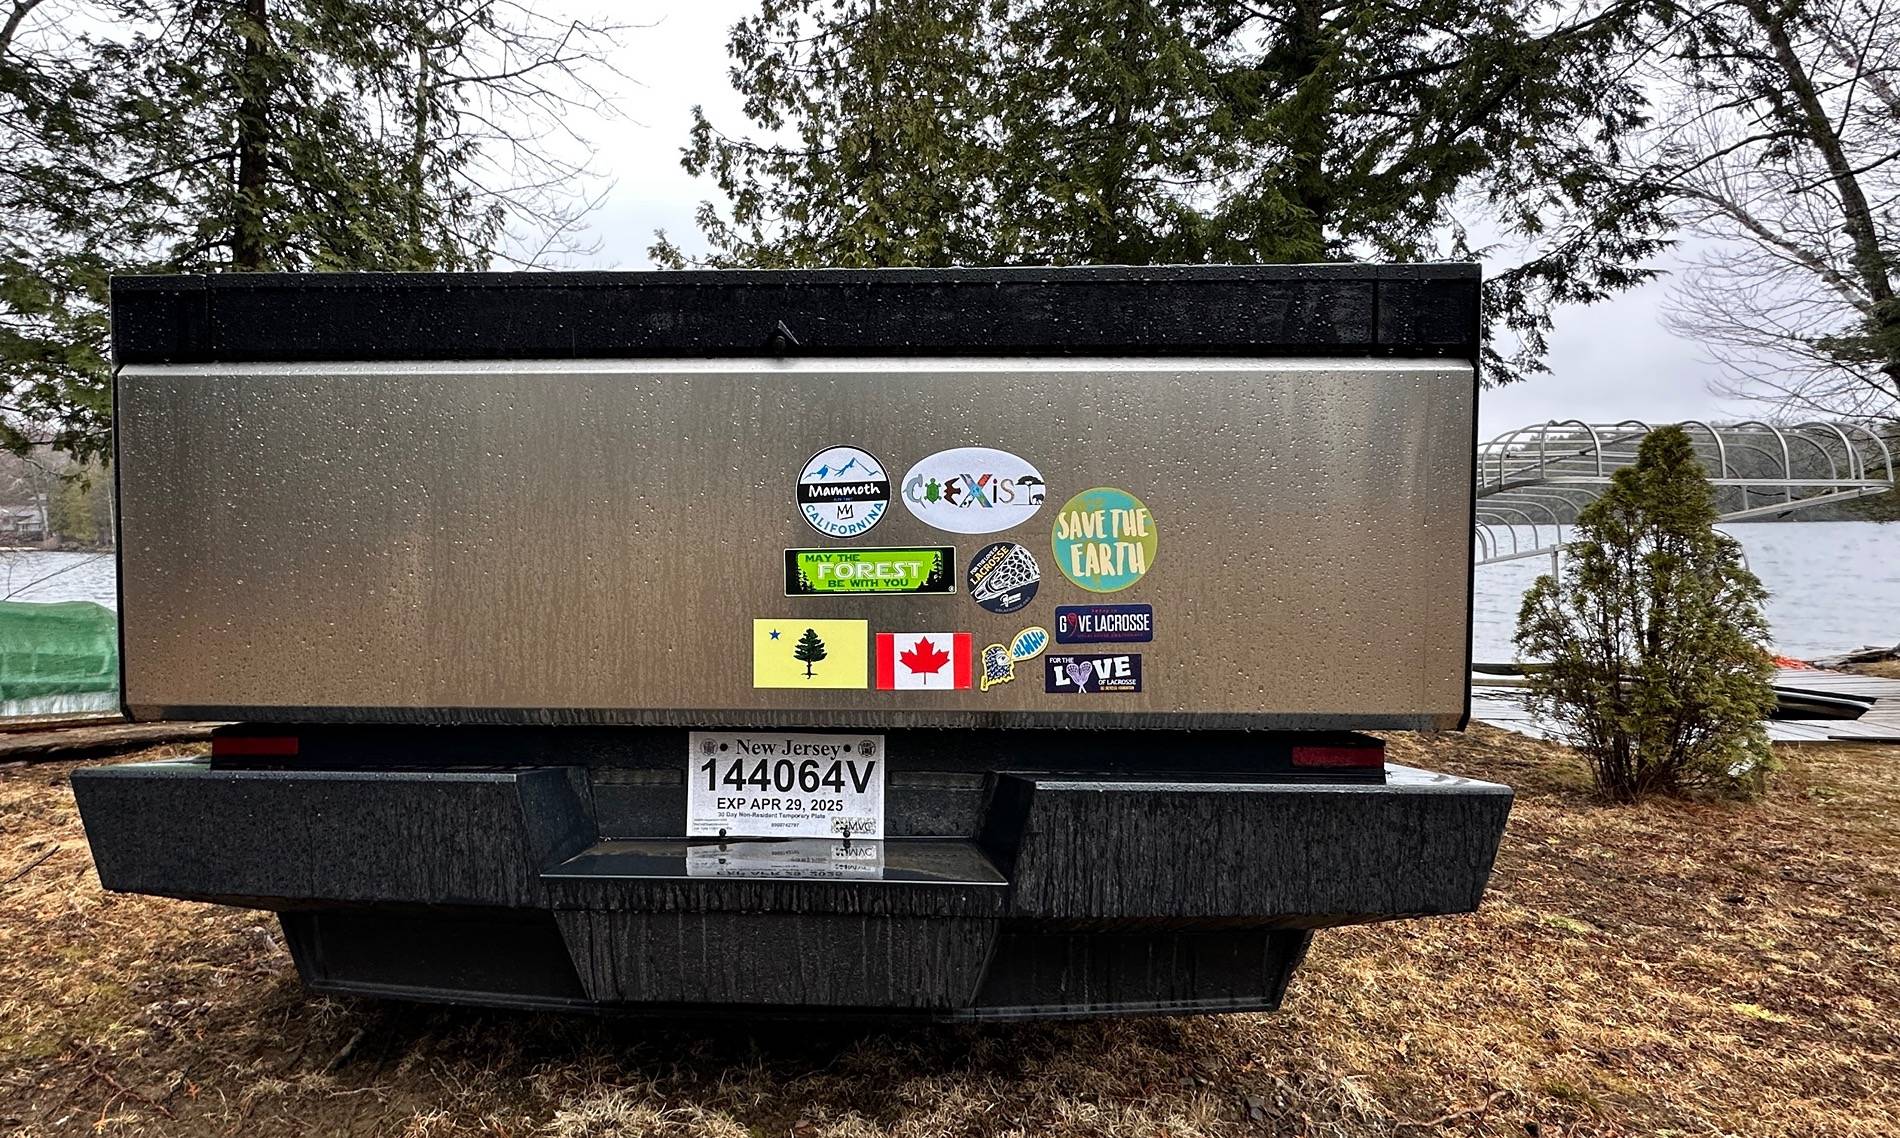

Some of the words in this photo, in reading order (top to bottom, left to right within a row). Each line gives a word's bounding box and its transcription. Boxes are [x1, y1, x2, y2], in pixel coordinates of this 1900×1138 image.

[808, 482, 881, 498] Mammoth
[805, 502, 884, 535] CALIFORNINA
[1057, 509, 1108, 540] SAVE
[1110, 508, 1149, 538] THE
[805, 554, 833, 562] MAY
[839, 554, 861, 562] THE
[970, 545, 1009, 585] LACROSSE
[1070, 541, 1146, 577] EARTH
[817, 560, 924, 580] FOREST
[850, 579, 879, 587] WITH
[884, 579, 909, 587] YOU
[1095, 613, 1150, 632] LACROSSE
[735, 739, 778, 755] New
[781, 739, 841, 760] Jersey
[701, 757, 876, 794] 144064V
[717, 797, 746, 810] EXP
[750, 798, 781, 810] APR
[785, 798, 806, 813] 29,
[810, 799, 843, 812] 2025
